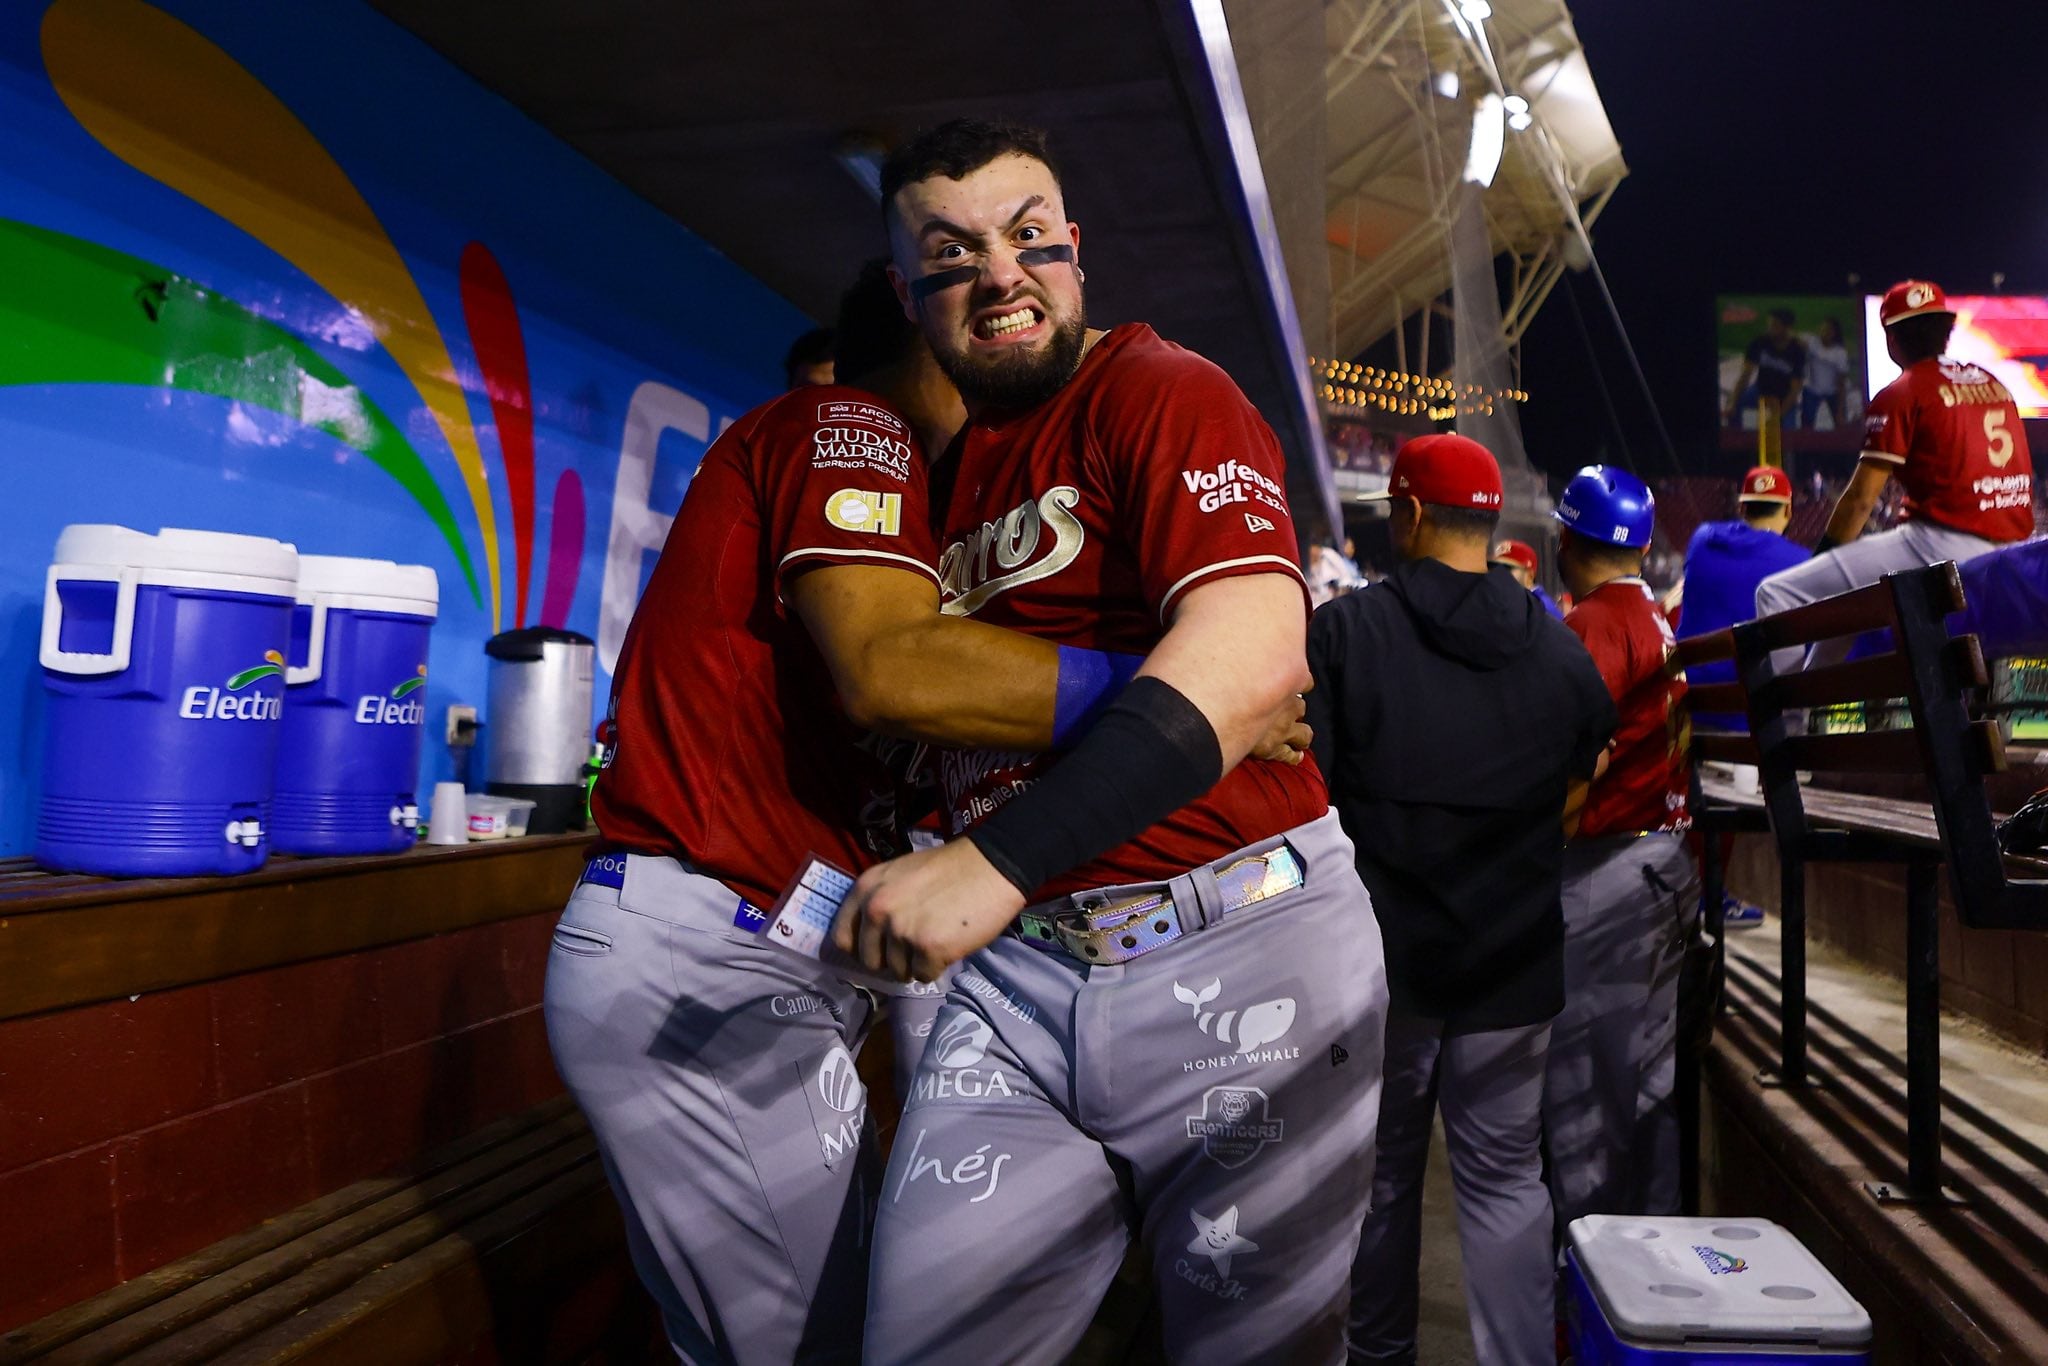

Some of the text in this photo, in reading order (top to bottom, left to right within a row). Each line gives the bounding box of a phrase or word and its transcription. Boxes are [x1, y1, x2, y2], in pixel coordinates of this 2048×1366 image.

[813, 427, 911, 462] CIUDAD
[1983, 409, 2014, 469] 5
[811, 442, 910, 476] MADERAS
[812, 460, 907, 483] TERRENOS PREMIUM
[1183, 1047, 1301, 1073] HONEY WHALE
[895, 1129, 1012, 1202] Inés
